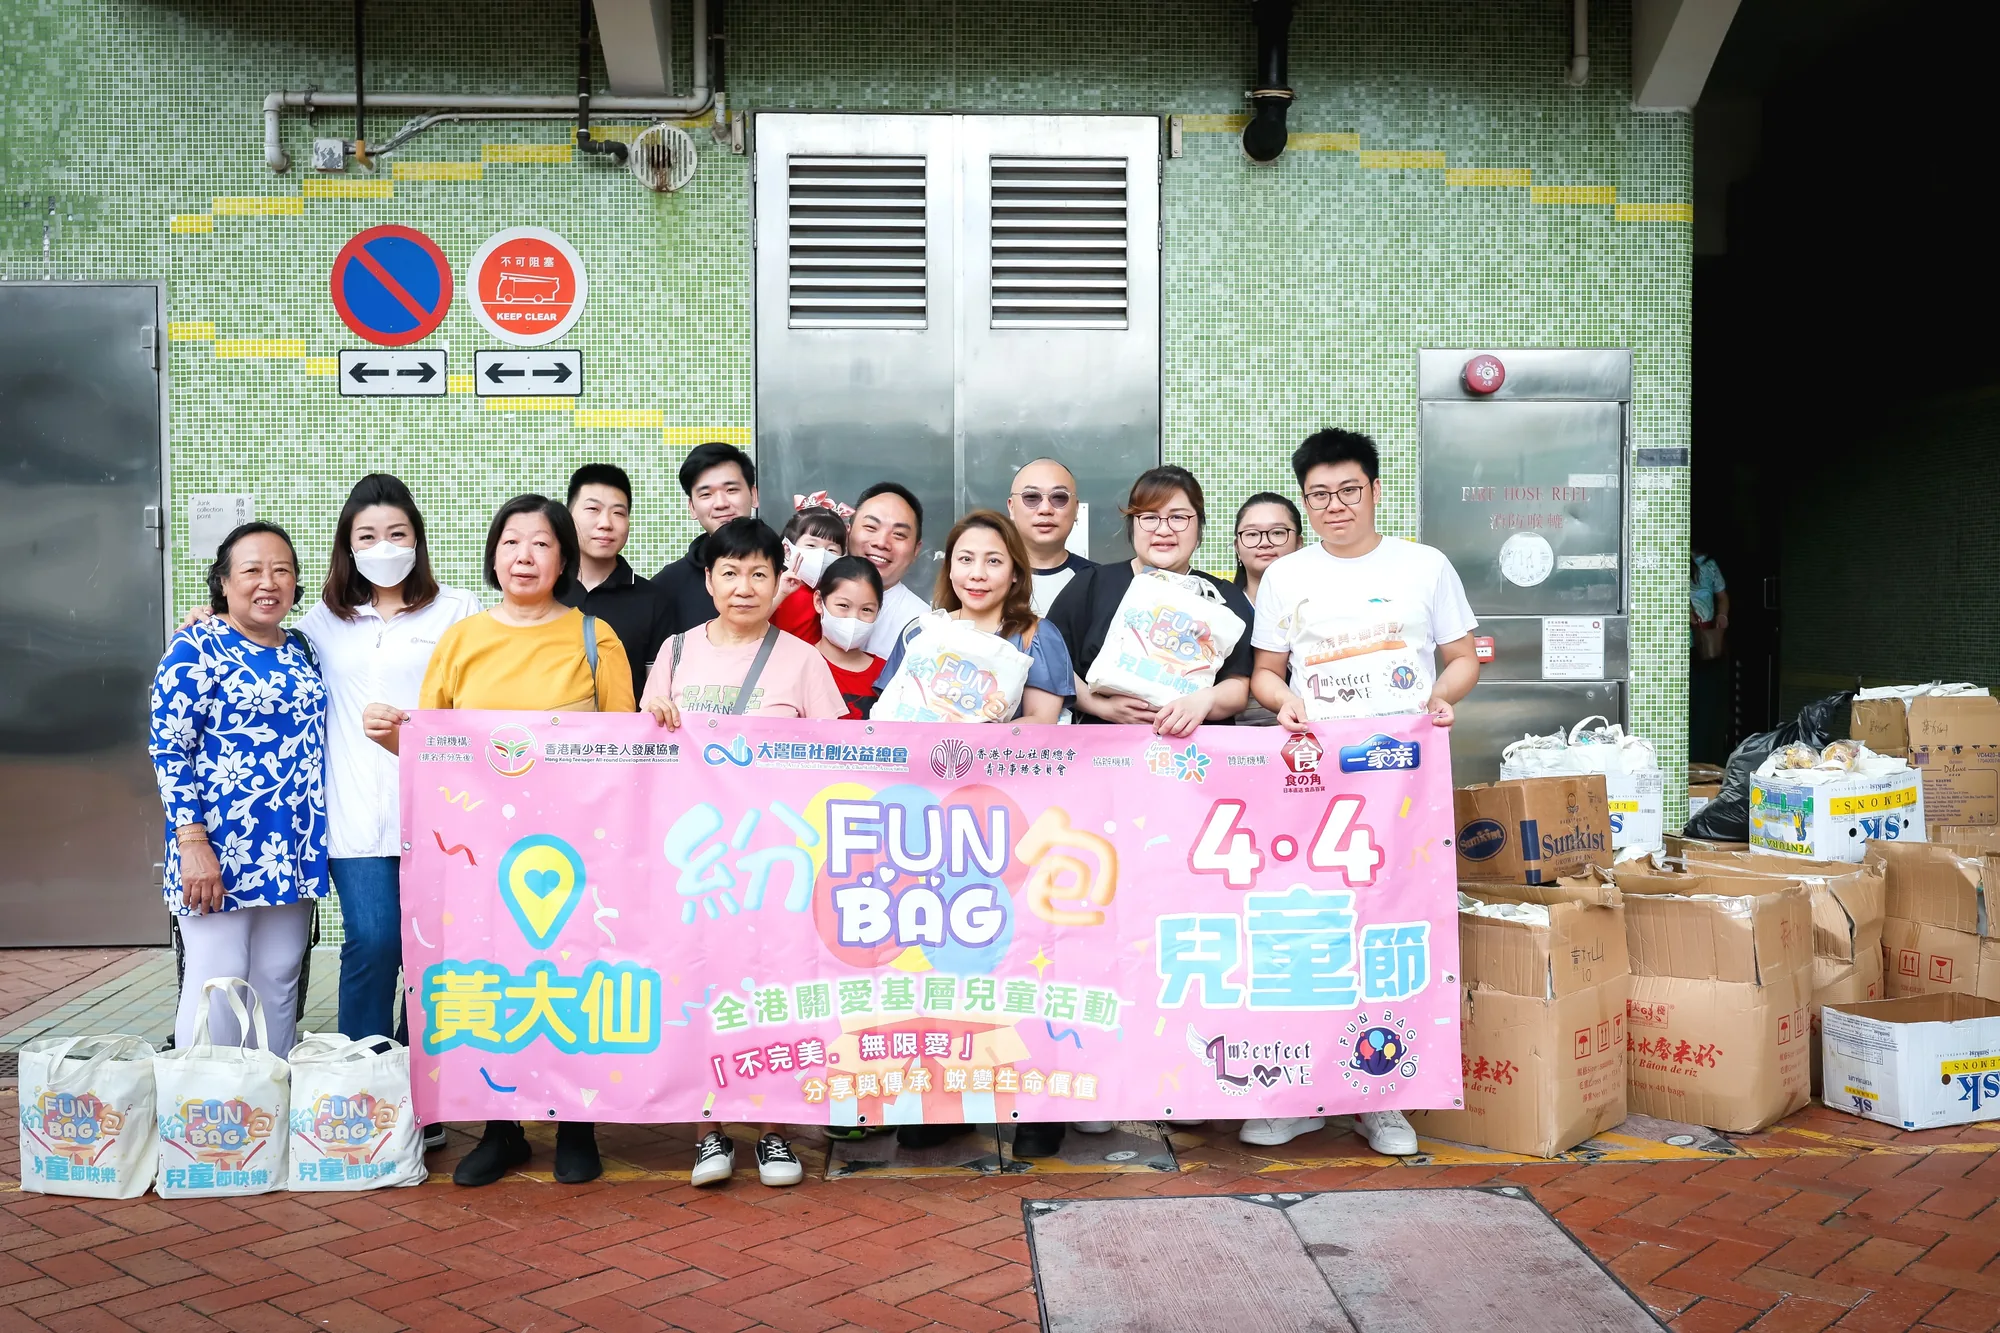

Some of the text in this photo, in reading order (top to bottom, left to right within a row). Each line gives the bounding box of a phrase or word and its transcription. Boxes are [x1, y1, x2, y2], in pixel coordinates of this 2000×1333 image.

[500, 256, 555, 268] 不可阻塞
[496, 312, 557, 320] KEEP CLEAR
[1157, 606, 1206, 640] FUN
[1152, 628, 1196, 656] BAG
[940, 656, 992, 695] FUN
[933, 680, 977, 710] BAG
[545, 744, 679, 756] 香港青少年全人發展協會
[757, 742, 908, 763] 大灣區社創公益總會
[976, 748, 1076, 762] 香港中山社團總會
[1285, 774, 1322, 786] 食の角
[1944, 764, 1966, 773] Deluxe
[1843, 792, 1910, 811] LEMONS
[826, 799, 1009, 879] FUN
[1459, 828, 1504, 852] Sunkist
[1542, 824, 1606, 861] Sunkist
[1766, 838, 1812, 854] VENTURA
[664, 800, 820, 924] 紛
[1014, 805, 1120, 926] 包
[834, 884, 1006, 948] BAG
[1156, 884, 1431, 1011] 兒童節
[429, 970, 651, 1044] 黃大仙
[712, 975, 1118, 1032] 全港關愛基層兒童活動
[1340, 1010, 1416, 1046] FUN BAG
[1339, 1060, 1368, 1093] PASS
[1381, 1083, 1395, 1093] IT
[1670, 1064, 1682, 1074] de
[1684, 1068, 1698, 1078] riz
[1954, 1058, 2000, 1071] EMONS
[804, 1066, 1098, 1103] 分享與傳承 蛻變生命價值
[1471, 1082, 1496, 1094] de riz
[1668, 1086, 1686, 1098] bags
[44, 1096, 95, 1118] FUN
[188, 1104, 242, 1124] FUN
[317, 1098, 368, 1119] FUN
[372, 1098, 400, 1129] 包
[1469, 1104, 1486, 1116] bags
[48, 1122, 94, 1138] BAG
[99, 1104, 126, 1136] 包
[248, 1107, 276, 1138] 包
[318, 1123, 367, 1140] BAG
[190, 1130, 240, 1145] BAG
[166, 1163, 268, 1189] 兒童節快樂
[298, 1158, 396, 1182] 兒童節快樂
